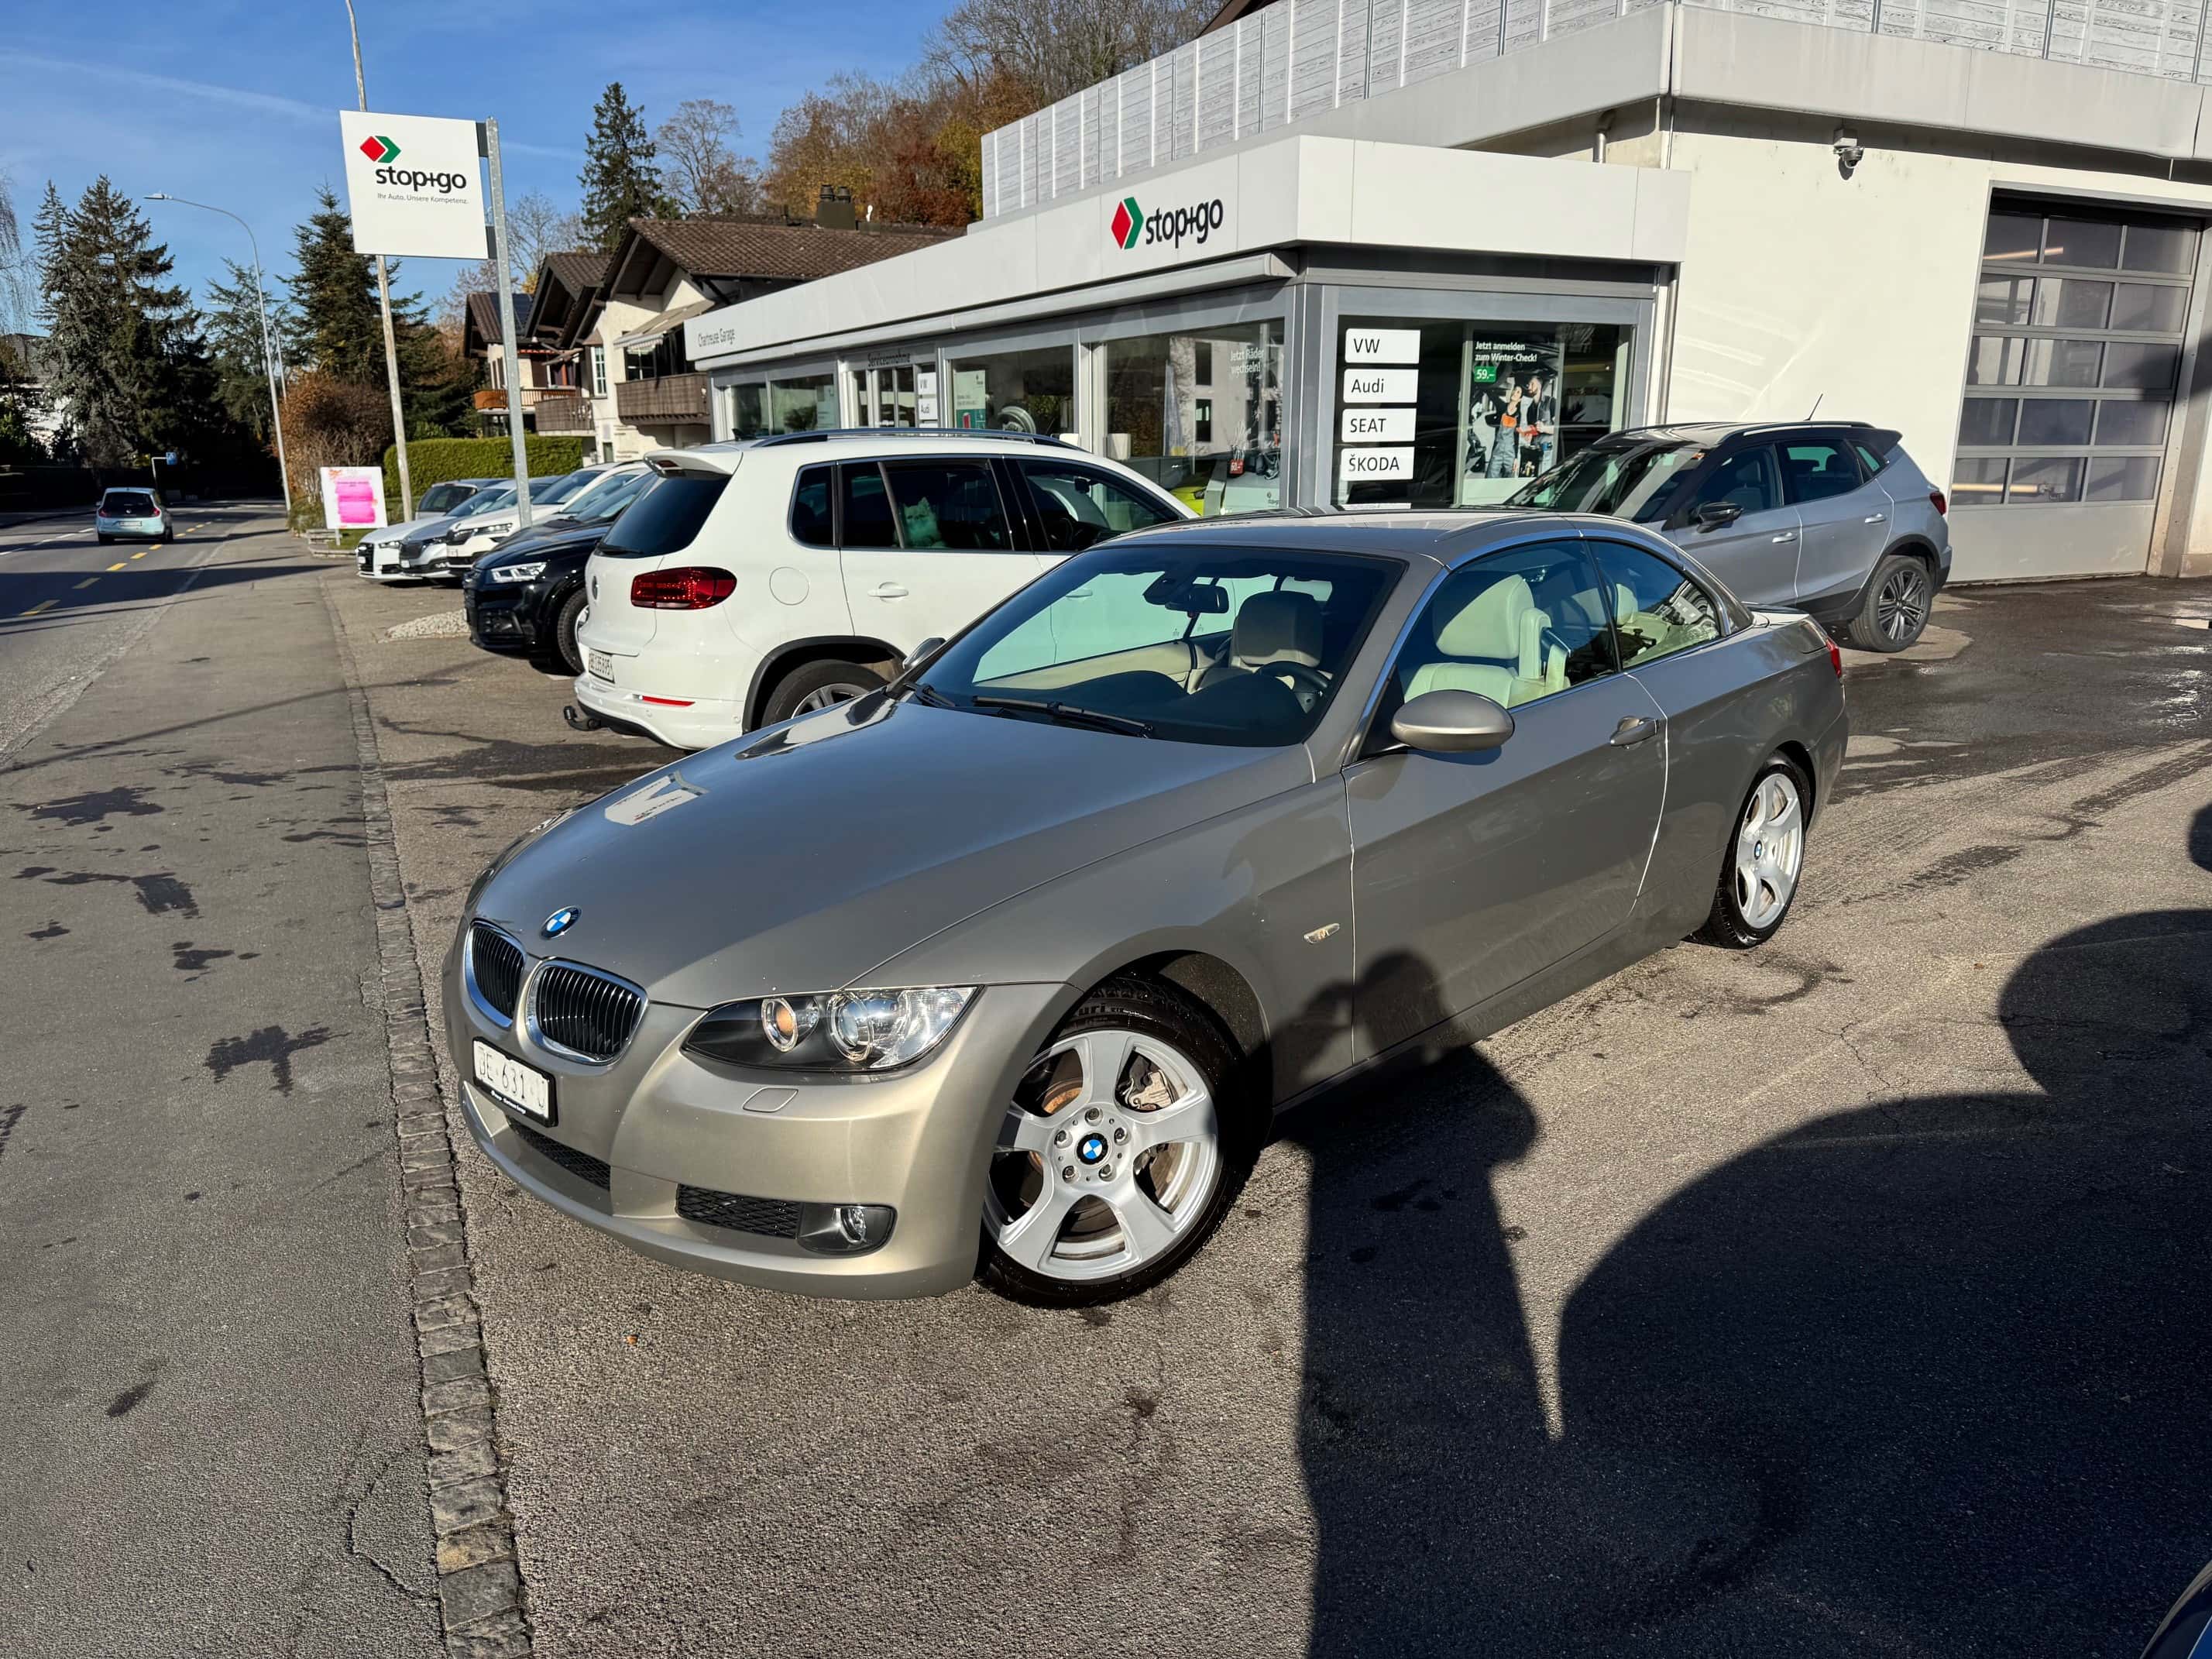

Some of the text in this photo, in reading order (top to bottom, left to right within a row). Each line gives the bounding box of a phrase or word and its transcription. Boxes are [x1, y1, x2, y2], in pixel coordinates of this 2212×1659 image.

[375, 166, 467, 194] stop+go
[1146, 198, 1224, 249] stop+go
[1353, 338, 1380, 353] VW
[1475, 341, 1526, 351] Jetzt anmelden
[1491, 352, 1537, 362] Winter-Check!
[1351, 377, 1384, 393] Audi
[1350, 418, 1387, 433] SEAT
[1348, 453, 1400, 472] ŠKODA
